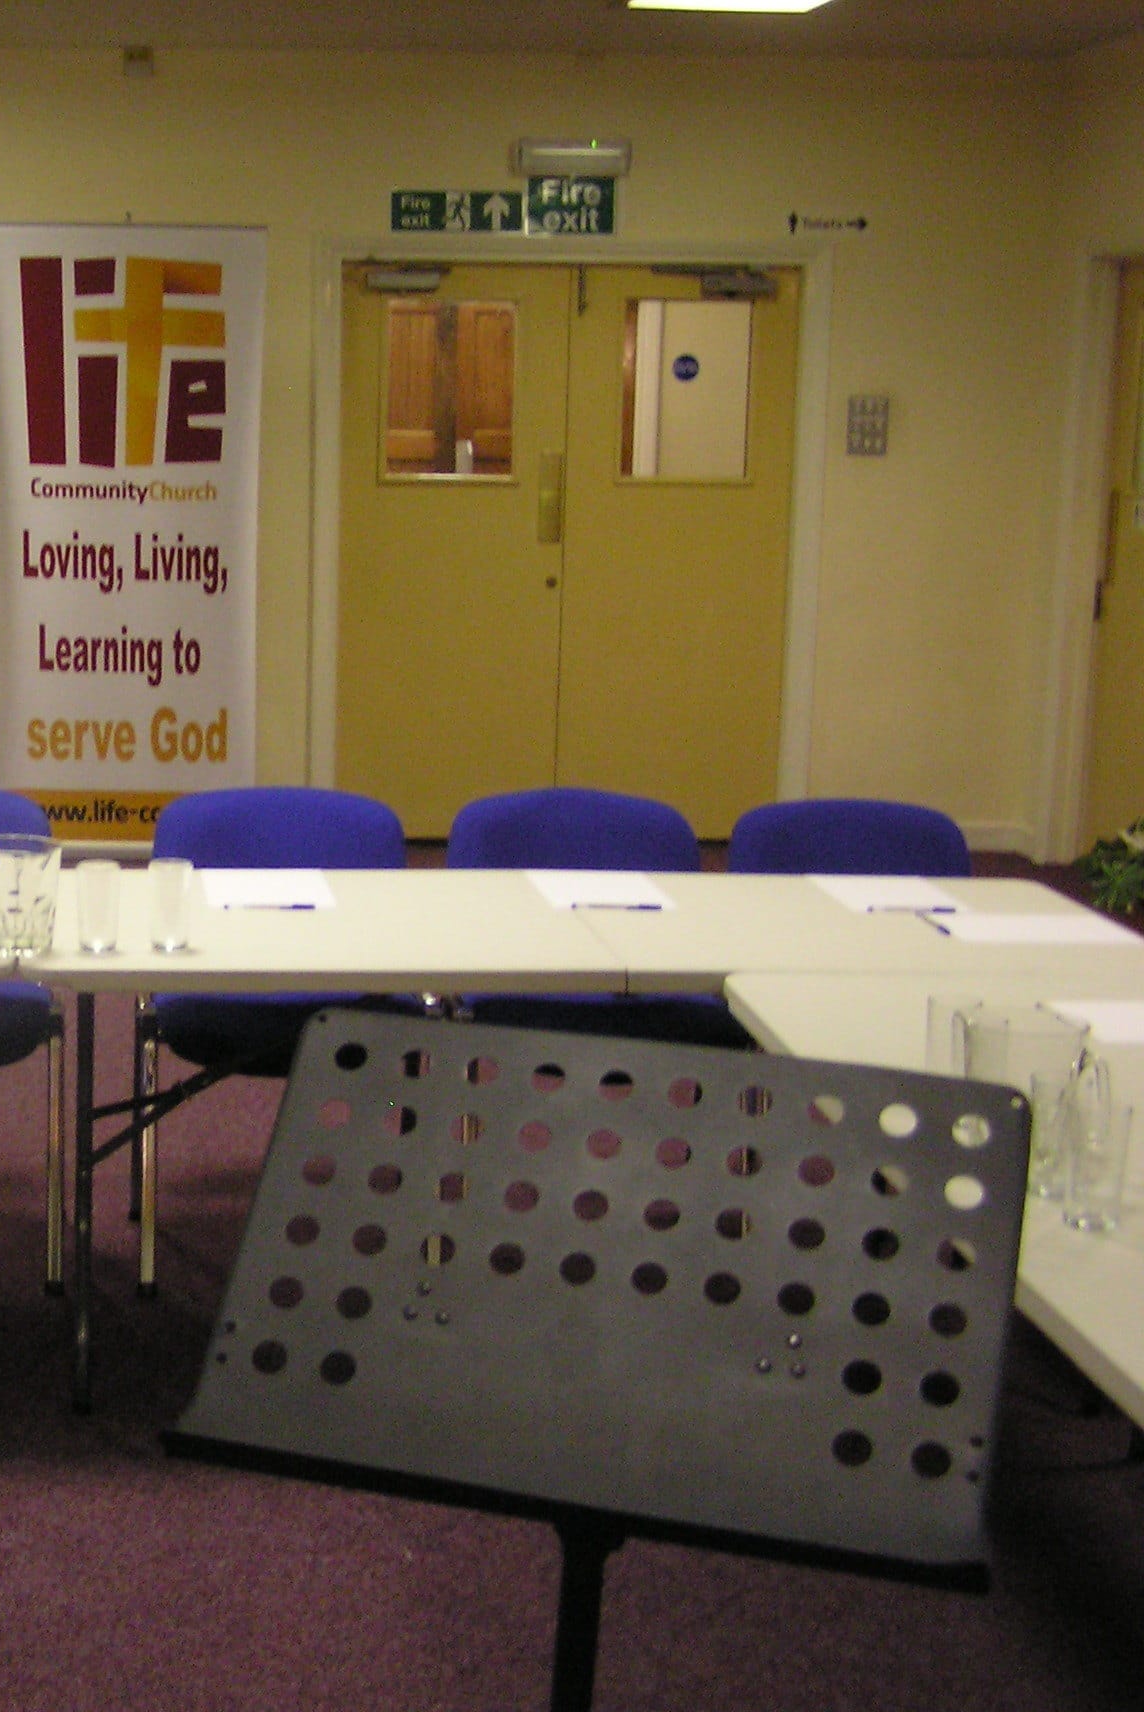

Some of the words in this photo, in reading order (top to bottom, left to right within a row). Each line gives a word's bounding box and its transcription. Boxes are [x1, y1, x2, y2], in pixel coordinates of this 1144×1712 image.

[541, 178, 601, 203] Fire
[543, 208, 599, 232] exit
[22, 529, 124, 593] Loving,
[134, 532, 228, 594] Living,
[39, 624, 163, 687] Learning
[173, 629, 201, 675] to
[27, 718, 136, 763] serve
[150, 706, 228, 763] God
